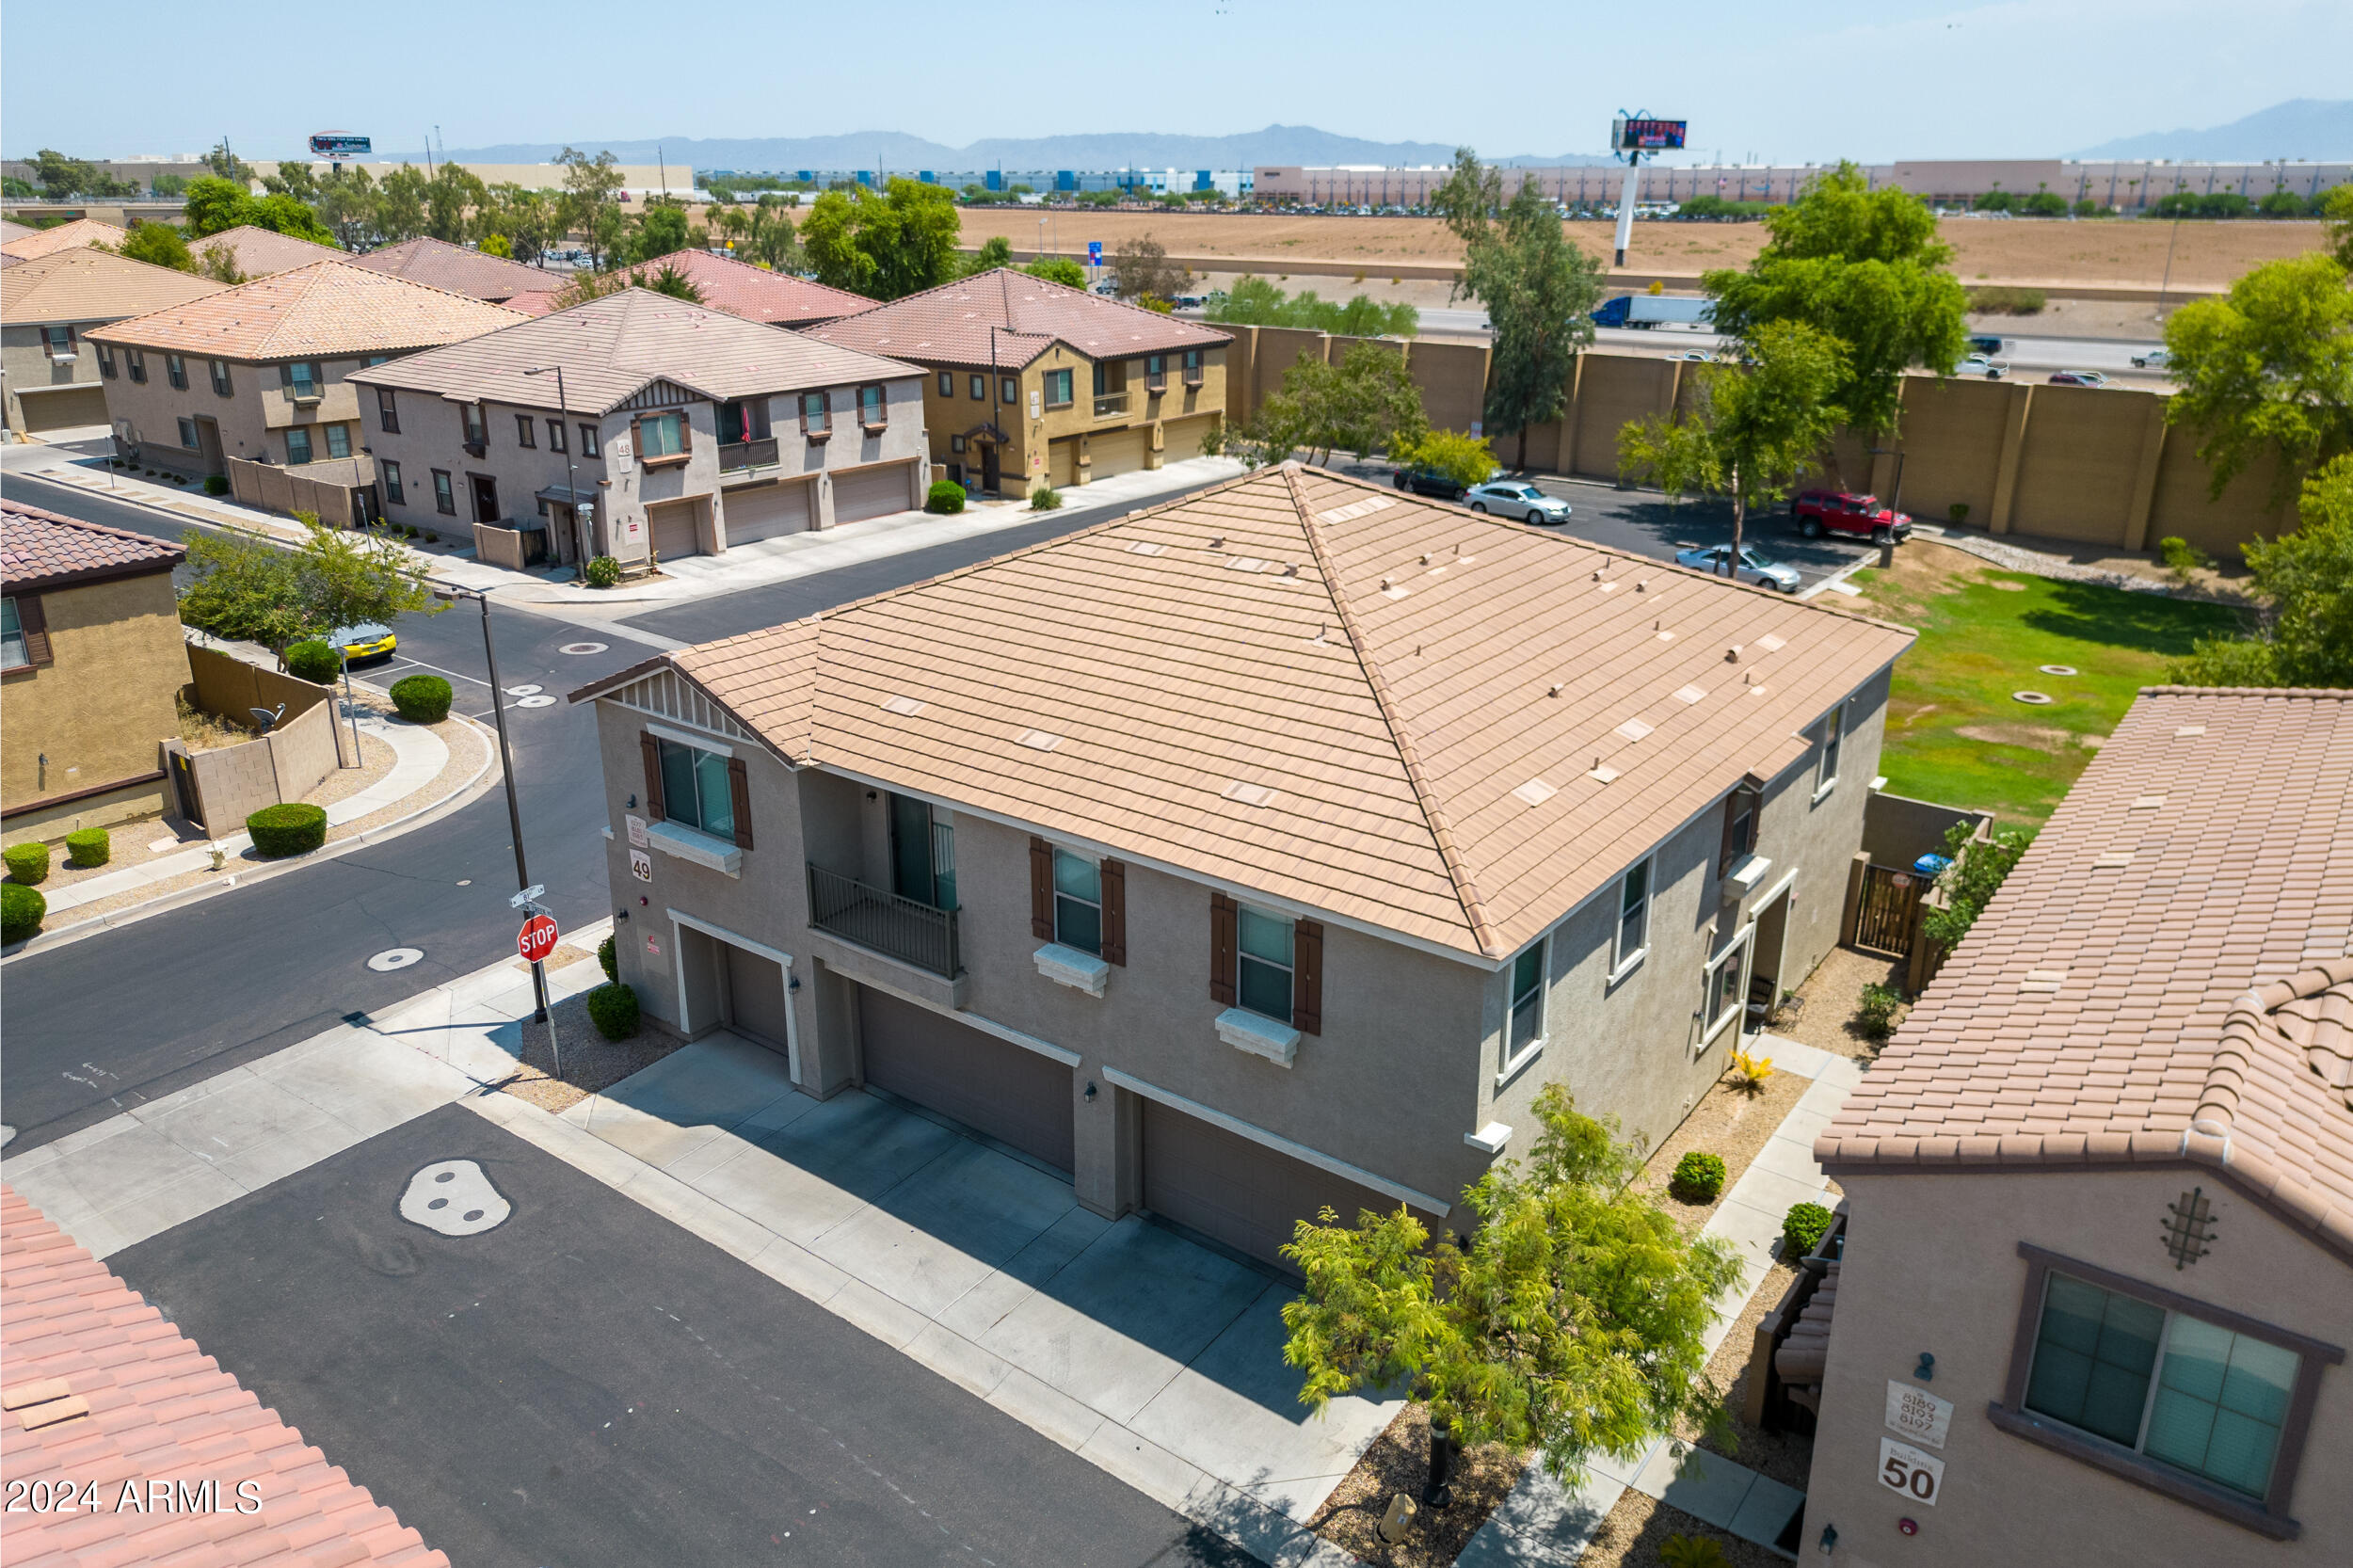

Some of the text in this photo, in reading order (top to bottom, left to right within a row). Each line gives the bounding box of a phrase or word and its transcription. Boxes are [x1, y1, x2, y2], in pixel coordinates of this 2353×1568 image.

[619, 444, 630, 454] 48
[633, 860, 650, 880] 49
[520, 924, 555, 953] STOP
[1900, 1402, 1934, 1422] 8193
[1902, 1392, 1936, 1412] 8189
[1899, 1413, 1933, 1431] 8197
[1890, 1447, 1933, 1473] Building
[1881, 1457, 1935, 1499] 50
